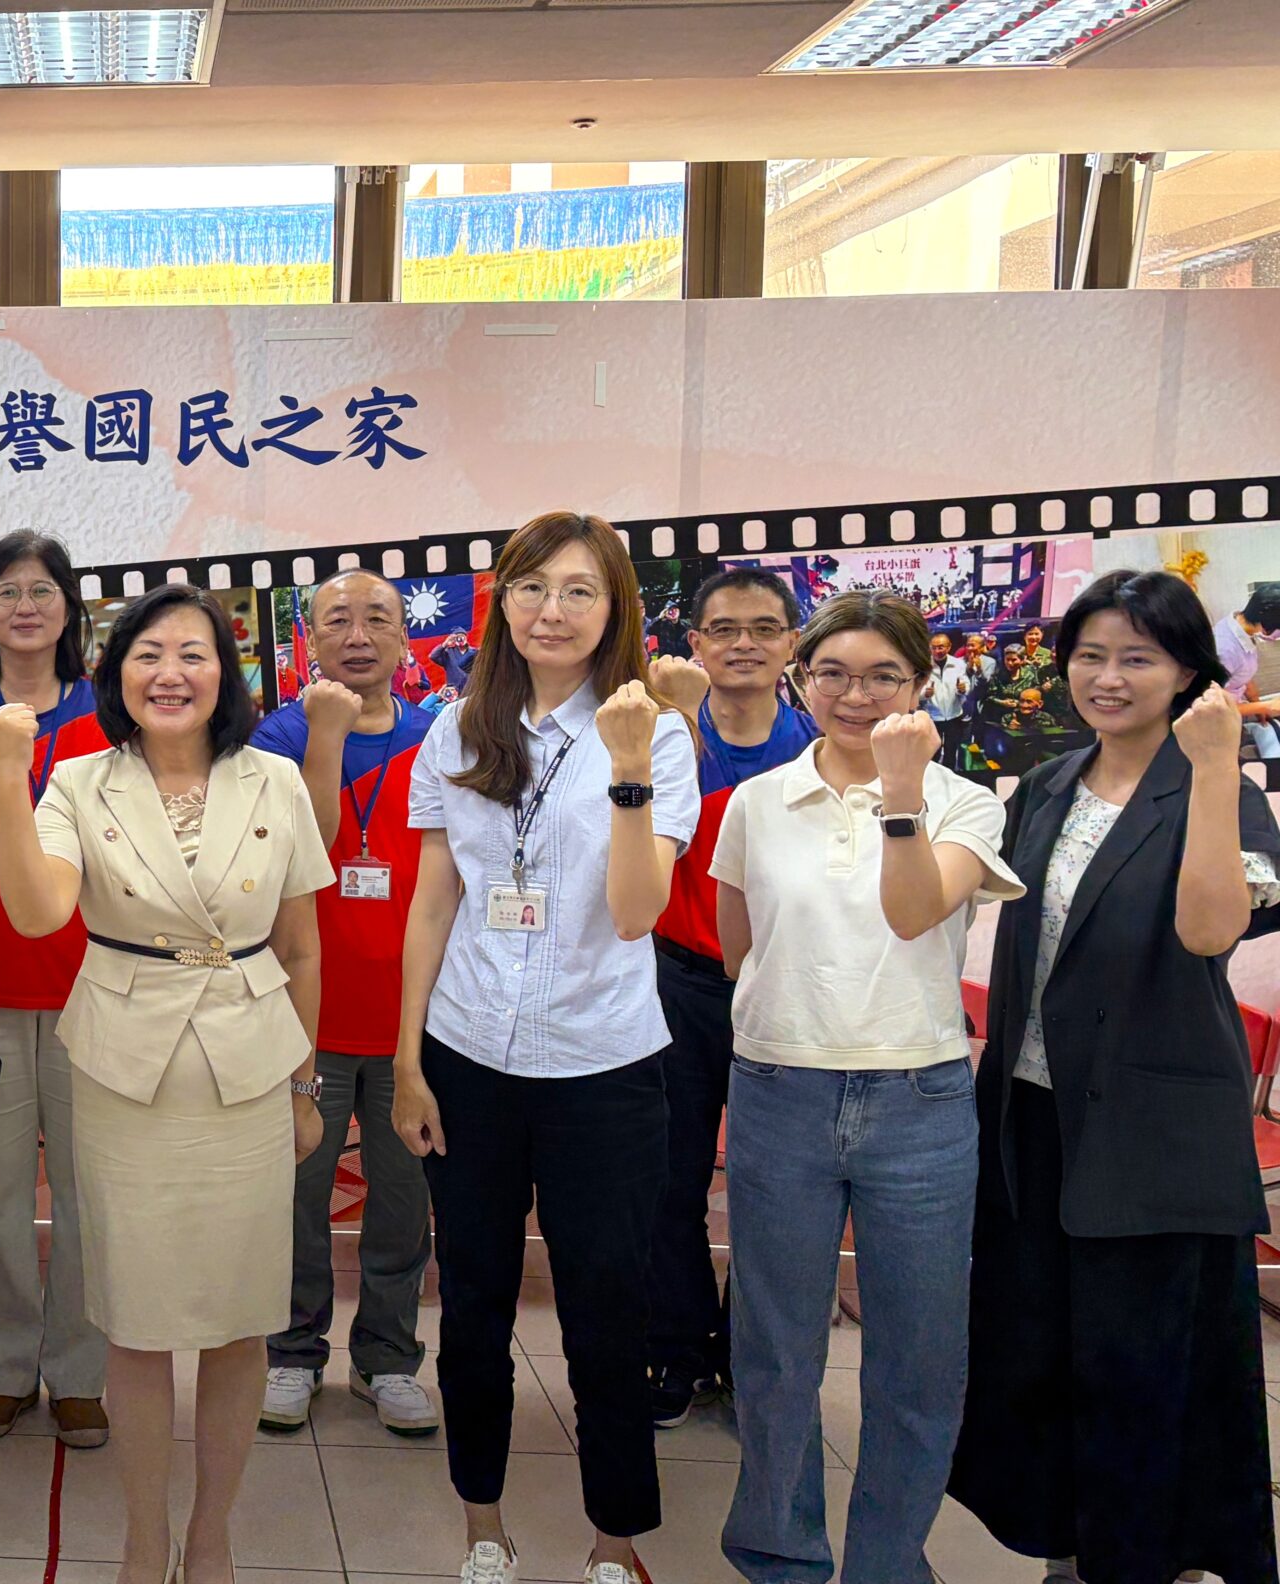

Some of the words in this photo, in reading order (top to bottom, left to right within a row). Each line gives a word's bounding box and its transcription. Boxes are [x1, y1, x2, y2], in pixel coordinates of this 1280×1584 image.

[864, 558, 921, 571] 台北小巨蛋
